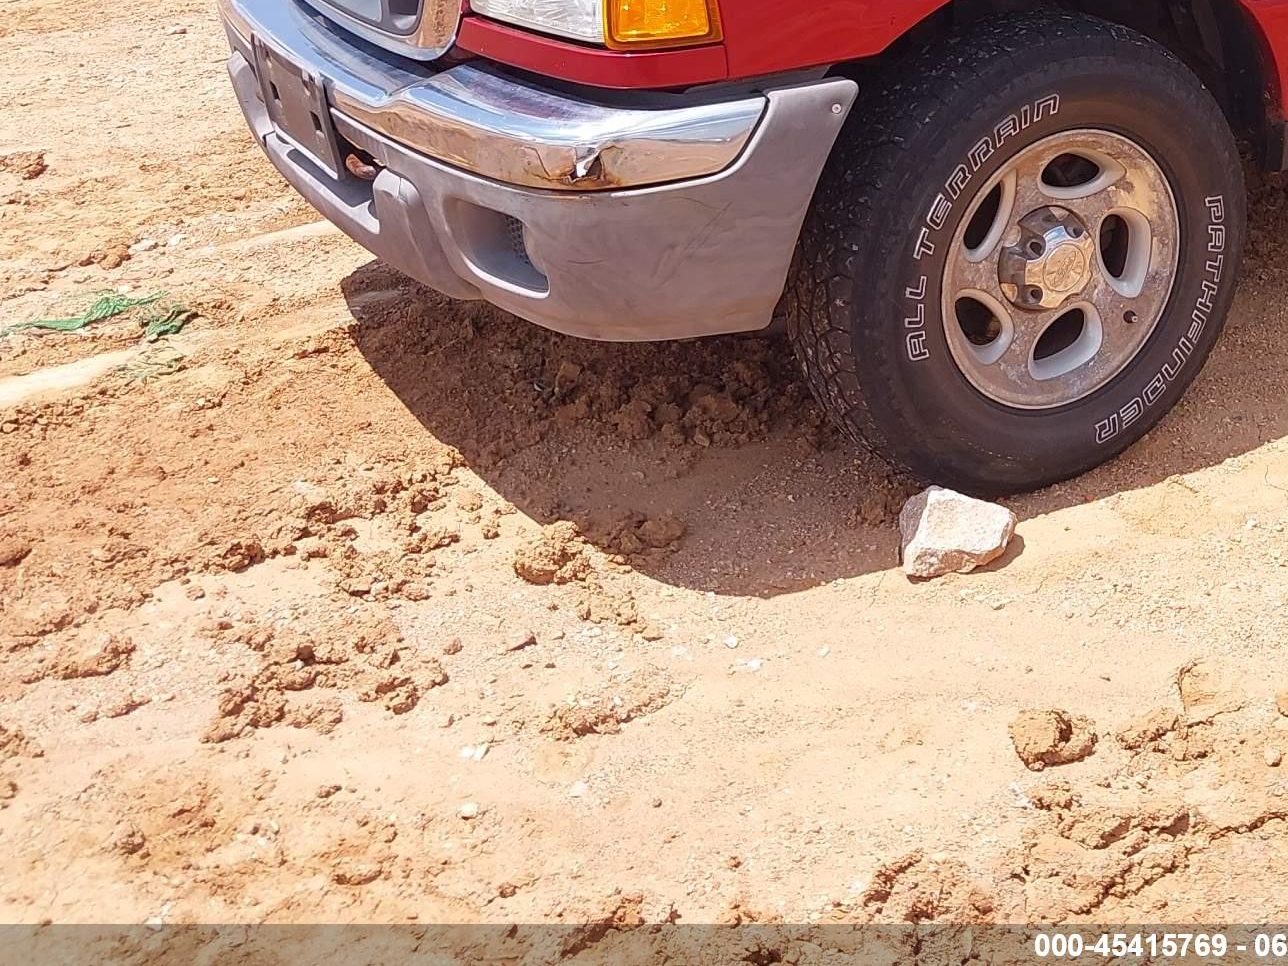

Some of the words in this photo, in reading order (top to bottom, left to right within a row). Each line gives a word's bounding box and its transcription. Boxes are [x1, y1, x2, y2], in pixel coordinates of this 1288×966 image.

[914, 94, 1060, 262] TERRAIN
[905, 275, 930, 361] ALL
[1095, 194, 1226, 444] PATHFINDER
